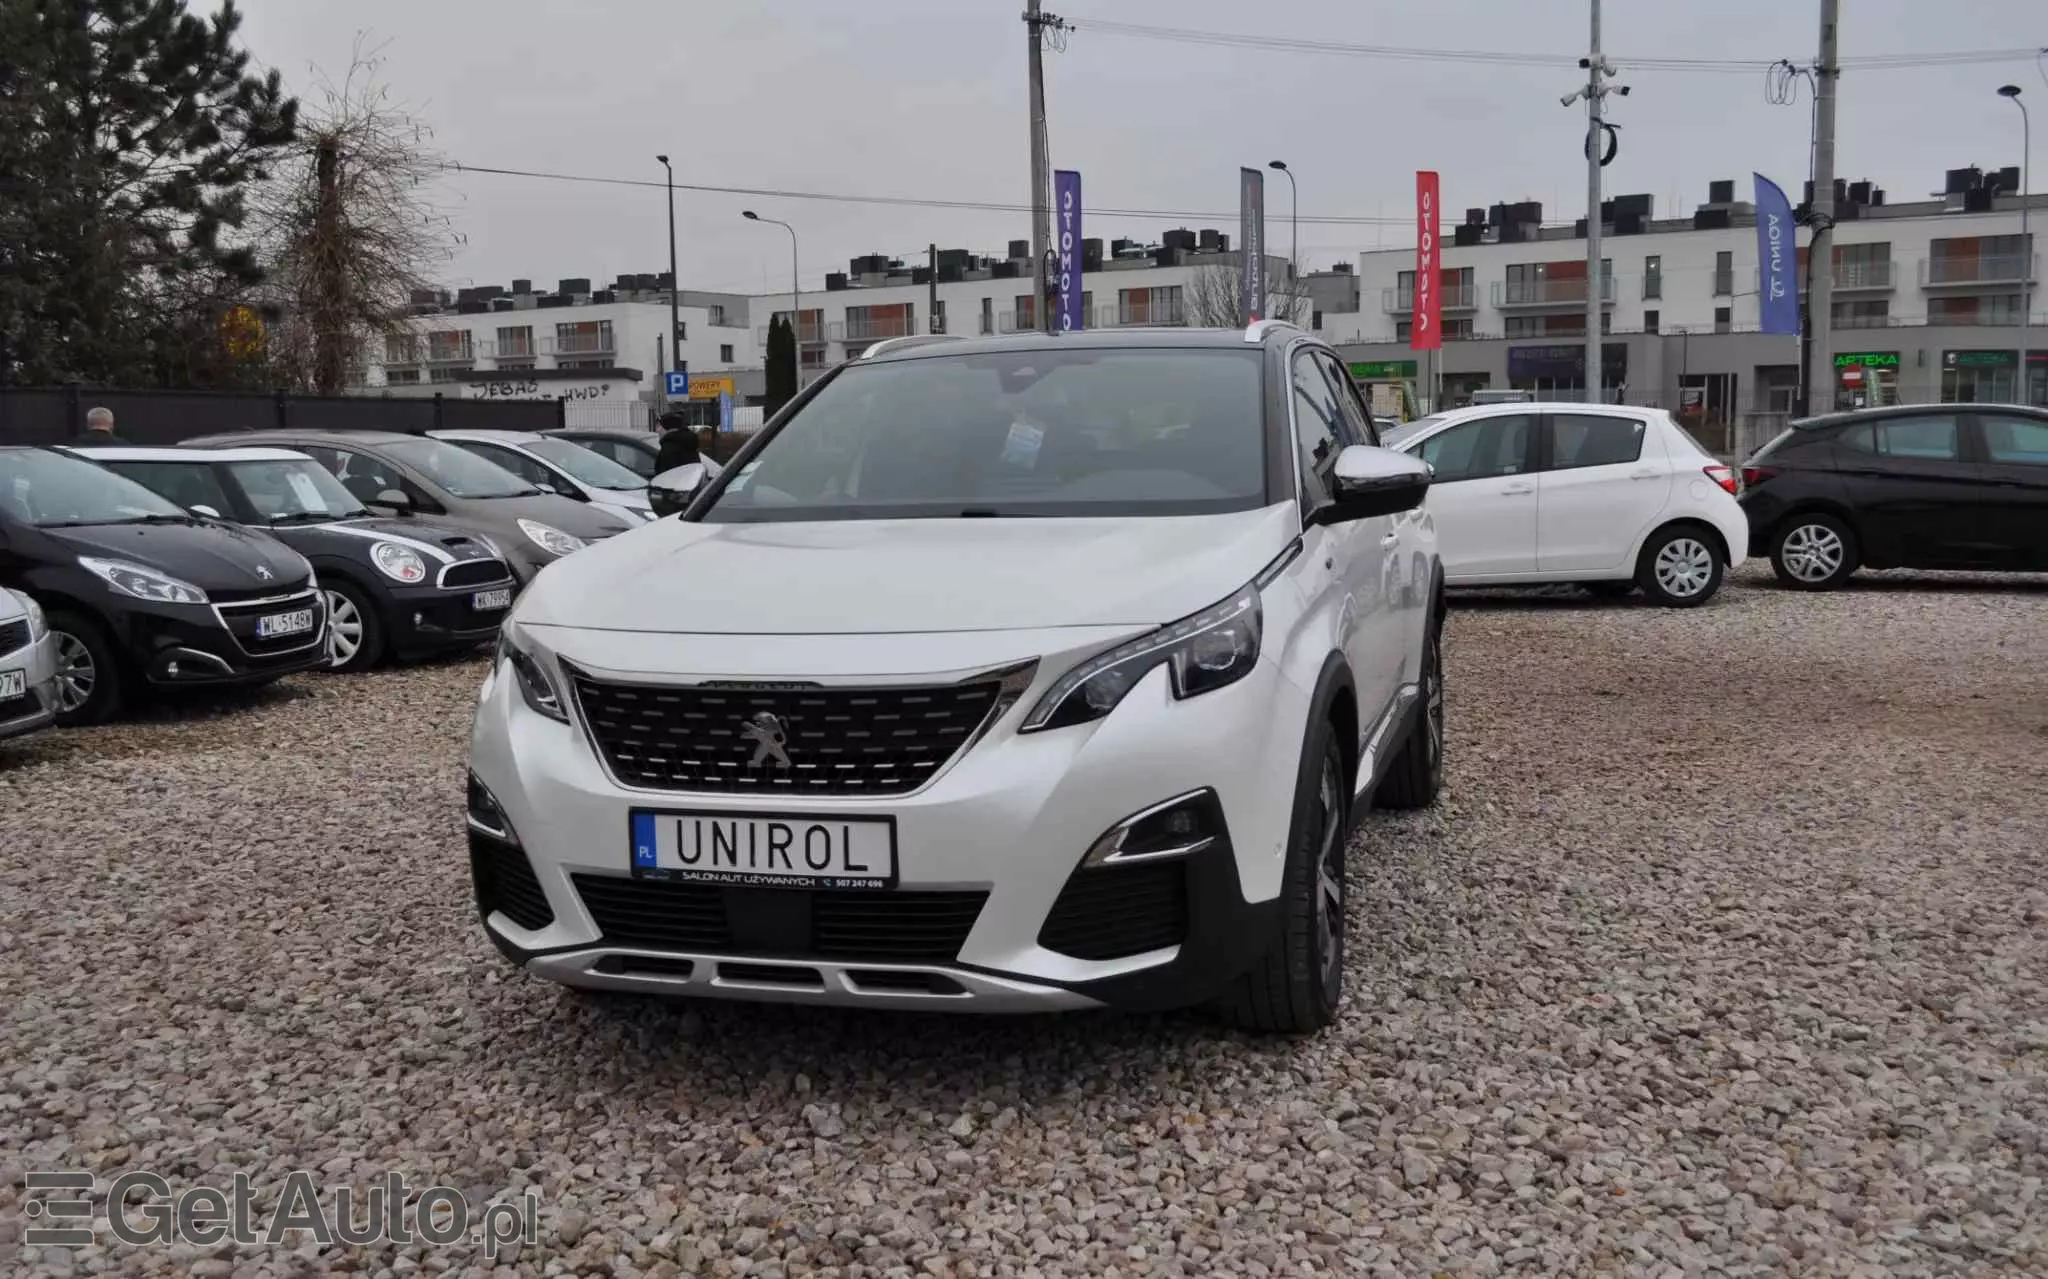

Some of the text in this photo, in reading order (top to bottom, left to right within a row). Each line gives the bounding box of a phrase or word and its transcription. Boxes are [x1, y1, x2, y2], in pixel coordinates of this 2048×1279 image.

[1060, 191, 1073, 330] OTOMOTO
[1835, 354, 1897, 366] APTEKA
[670, 374, 684, 392] P
[639, 846, 653, 858] PL
[676, 819, 869, 872] UNIROL
[682, 872, 719, 882] SALON
